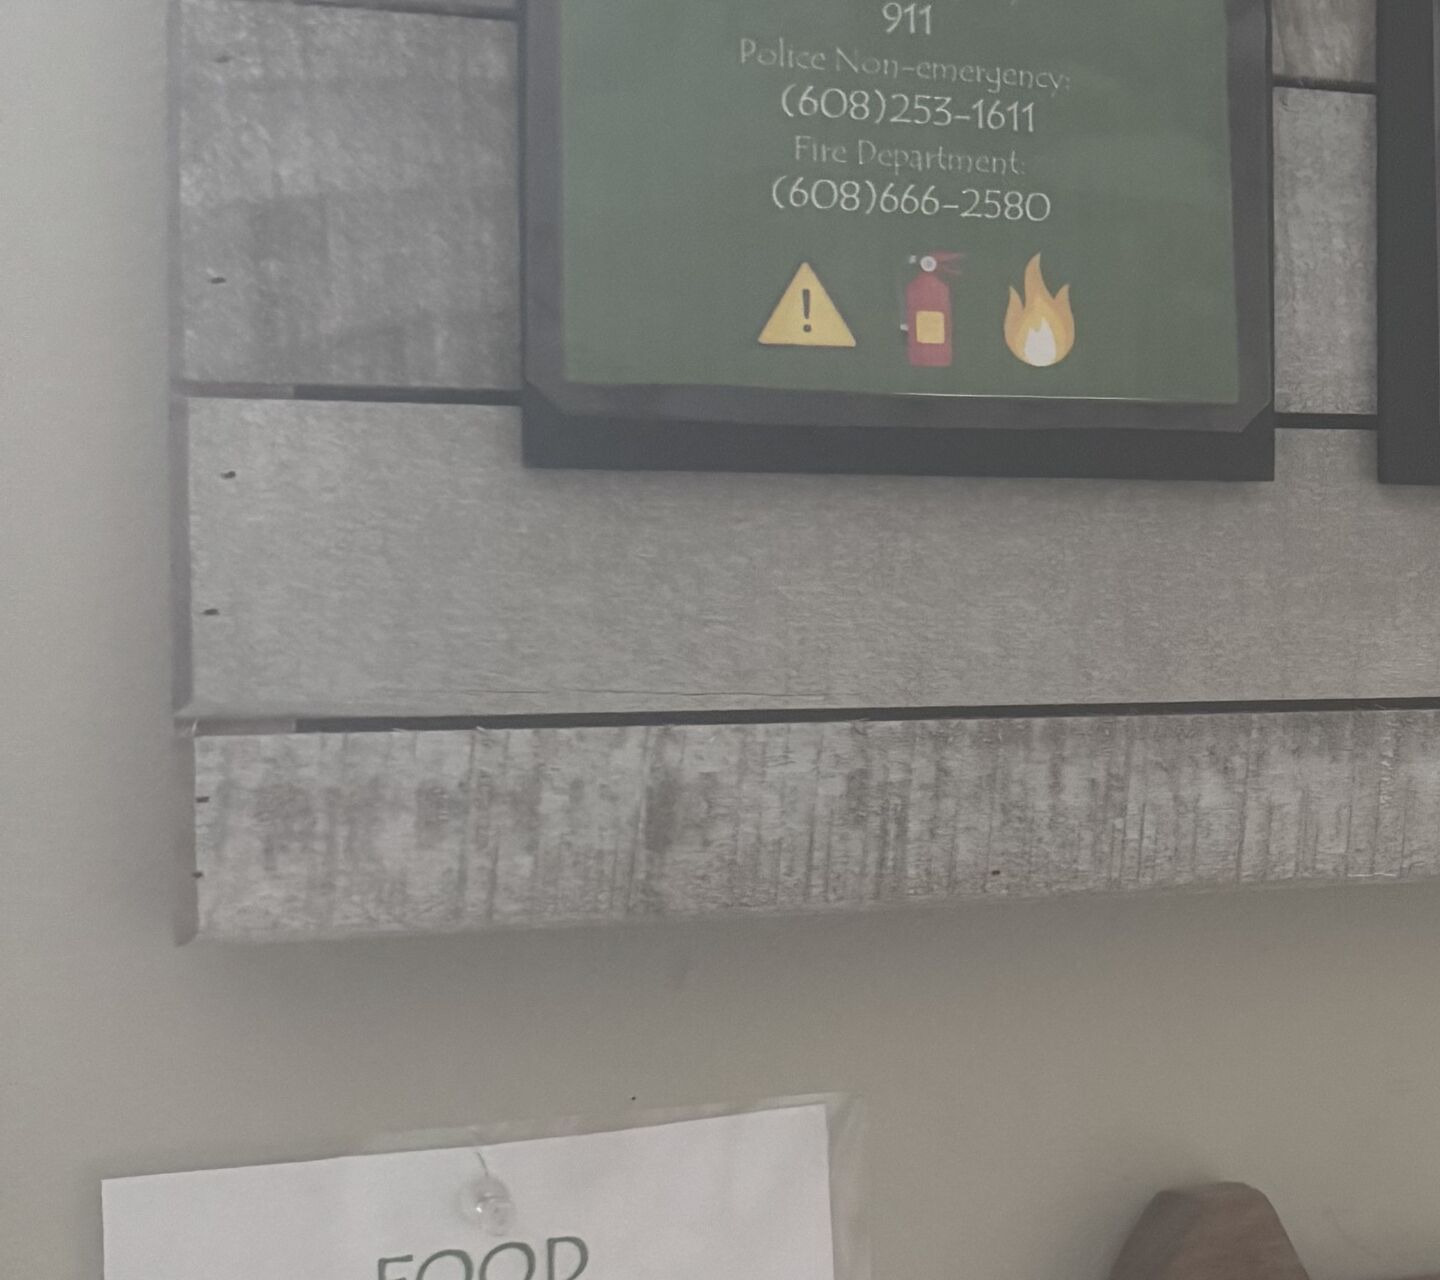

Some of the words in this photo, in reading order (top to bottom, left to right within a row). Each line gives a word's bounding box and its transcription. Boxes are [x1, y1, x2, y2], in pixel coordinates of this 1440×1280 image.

[881, 2, 933, 36] 911
[739, 37, 827, 71] Police
[835, 47, 1071, 98] Non-emergency:
[780, 83, 1036, 134] (608)253-1611
[794, 136, 847, 165] Fire
[858, 140, 1026, 177] Department:
[771, 174, 1052, 223] (608)666-2580
